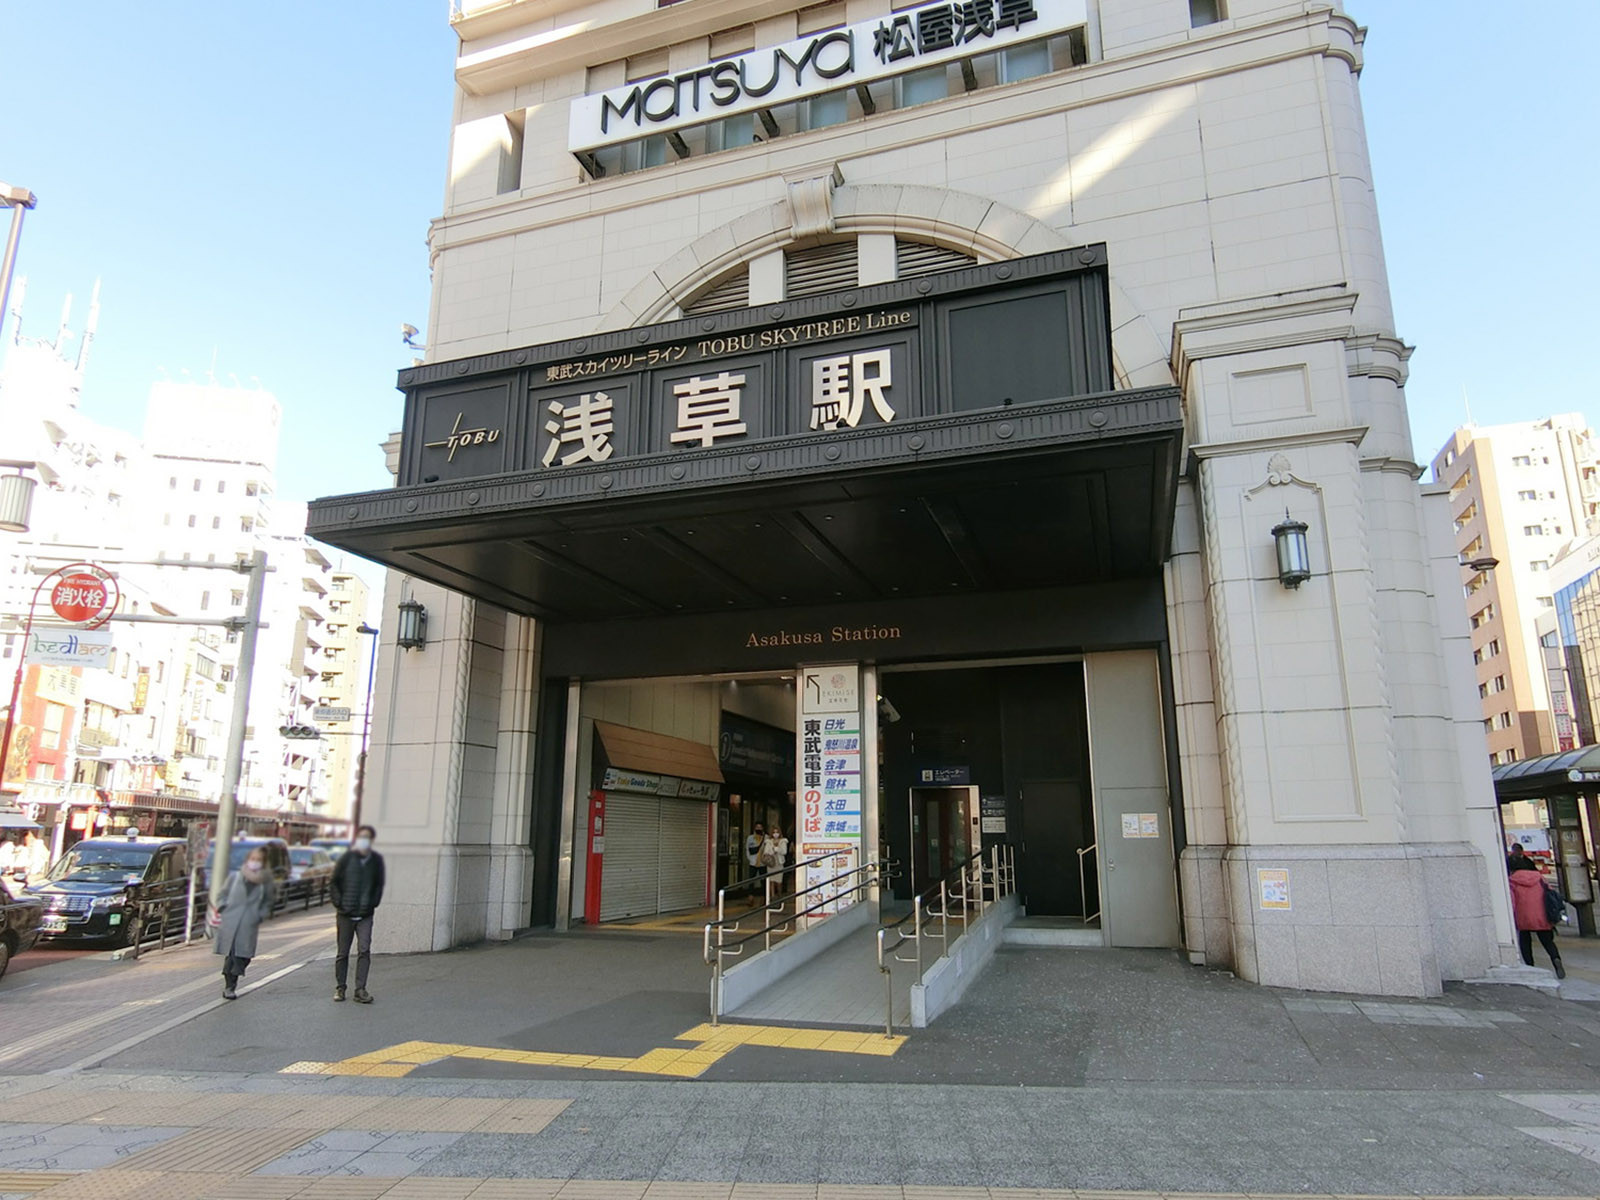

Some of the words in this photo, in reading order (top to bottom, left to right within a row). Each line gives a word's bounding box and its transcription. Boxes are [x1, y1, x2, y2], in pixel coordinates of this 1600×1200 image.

[872, 0, 1039, 65] 松屋浅草
[698, 334, 755, 358] TOBU
[760, 315, 861, 347] SKYTREE
[866, 310, 911, 330] Line
[546, 345, 687, 381] 東武スカイツリーライン
[446, 428, 500, 449] TOBU
[55, 586, 105, 609] 消火栓
[745, 630, 823, 648] Asakusa
[831, 624, 902, 642] Station
[825, 718, 846, 730] 日光
[804, 719, 822, 833] 東武電車のりば
[825, 759, 847, 771] 会津
[825, 778, 847, 790] 館林
[825, 799, 847, 811] 太田
